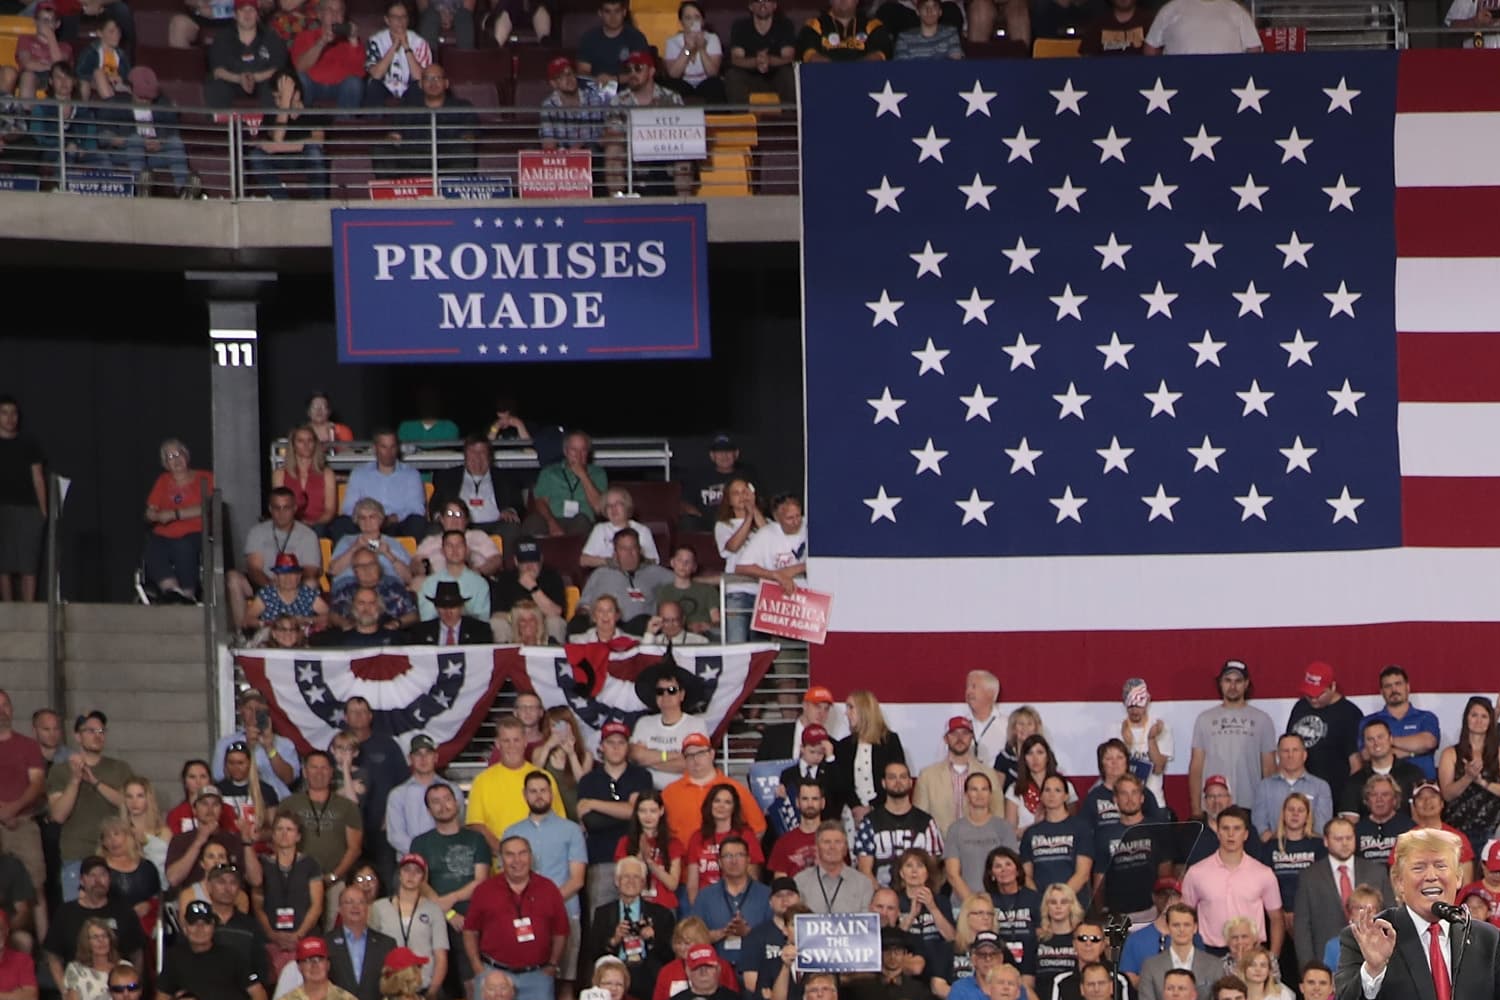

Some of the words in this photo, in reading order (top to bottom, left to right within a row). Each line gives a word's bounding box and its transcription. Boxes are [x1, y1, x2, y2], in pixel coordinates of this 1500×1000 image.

[637, 131, 702, 140] AMERICA
[654, 144, 684, 152] GREAT
[543, 158, 567, 166] MAKE
[523, 169, 589, 180] AMERICA
[373, 241, 667, 281] PROMISES
[439, 292, 605, 329] MADE
[214, 343, 253, 366] 111
[759, 598, 826, 624] AMERICA
[761, 614, 790, 627] GREAT
[791, 619, 820, 633] AGAIN
[1032, 835, 1073, 848] STAUBER
[995, 908, 1031, 921] AUBER
[806, 919, 868, 936] DRAIN
[826, 937, 849, 947] THE
[801, 948, 872, 964] SWAMP
